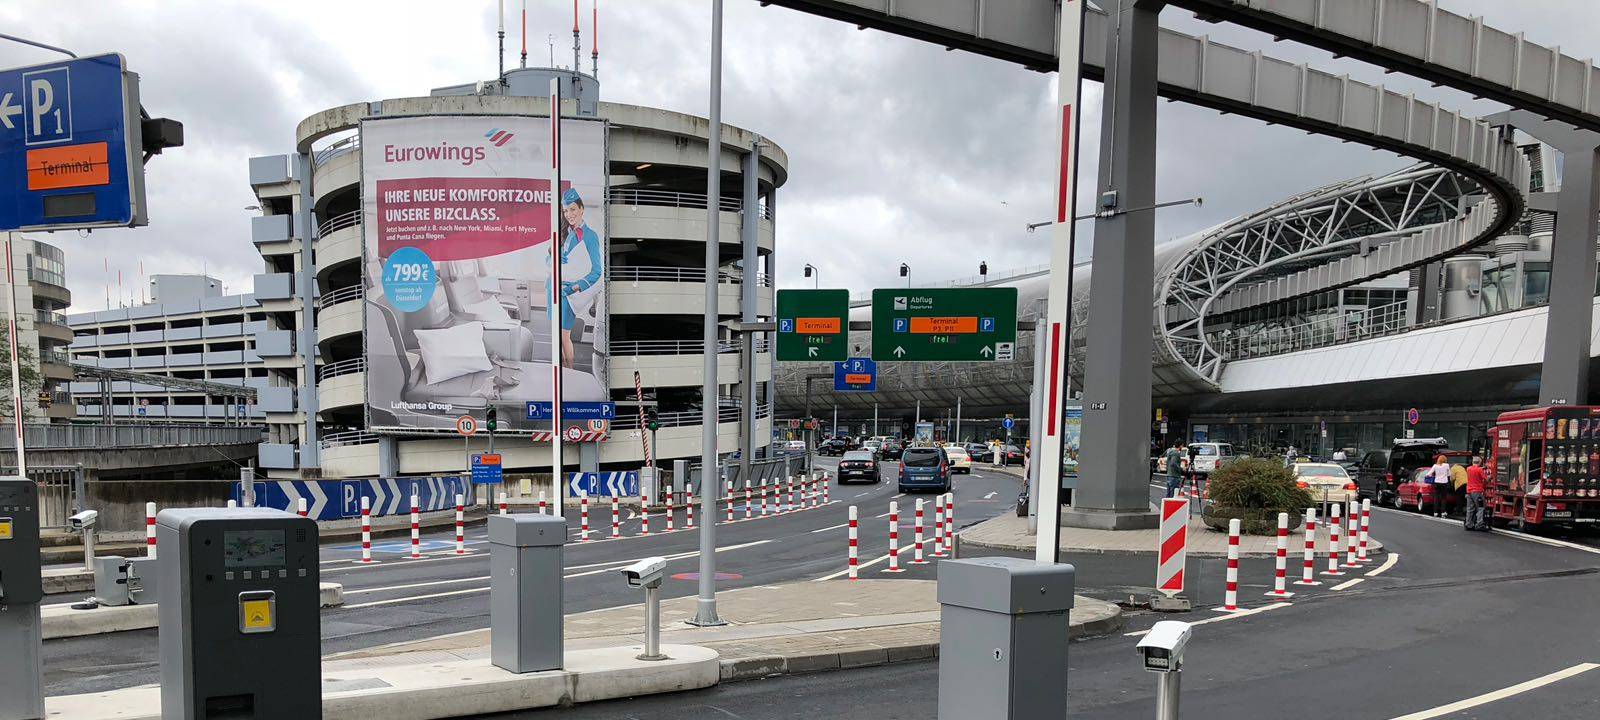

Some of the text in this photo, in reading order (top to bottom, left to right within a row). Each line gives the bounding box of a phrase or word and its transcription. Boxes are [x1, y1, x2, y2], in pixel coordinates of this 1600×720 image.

[31, 79, 63, 135] P1
[384, 141, 486, 166] Eurowings
[41, 156, 94, 176] Terminal
[385, 189, 551, 204] IHRE NEUE KOMFORTZONE
[385, 207, 499, 222] UNSERE BIZCLASS.
[398, 225, 416, 233] buchen
[519, 226, 537, 234] Myers
[393, 263, 421, 282] 799
[422, 270, 429, 281] €
[781, 320, 791, 331] P2
[896, 320, 904, 331] P
[983, 319, 991, 330] P
[808, 335, 824, 343] frei
[933, 335, 949, 343] frei
[390, 401, 453, 411] Lufthansa Group
[462, 421, 472, 431] 10
[593, 420, 602, 429] 10
[344, 484, 358, 513] P1
